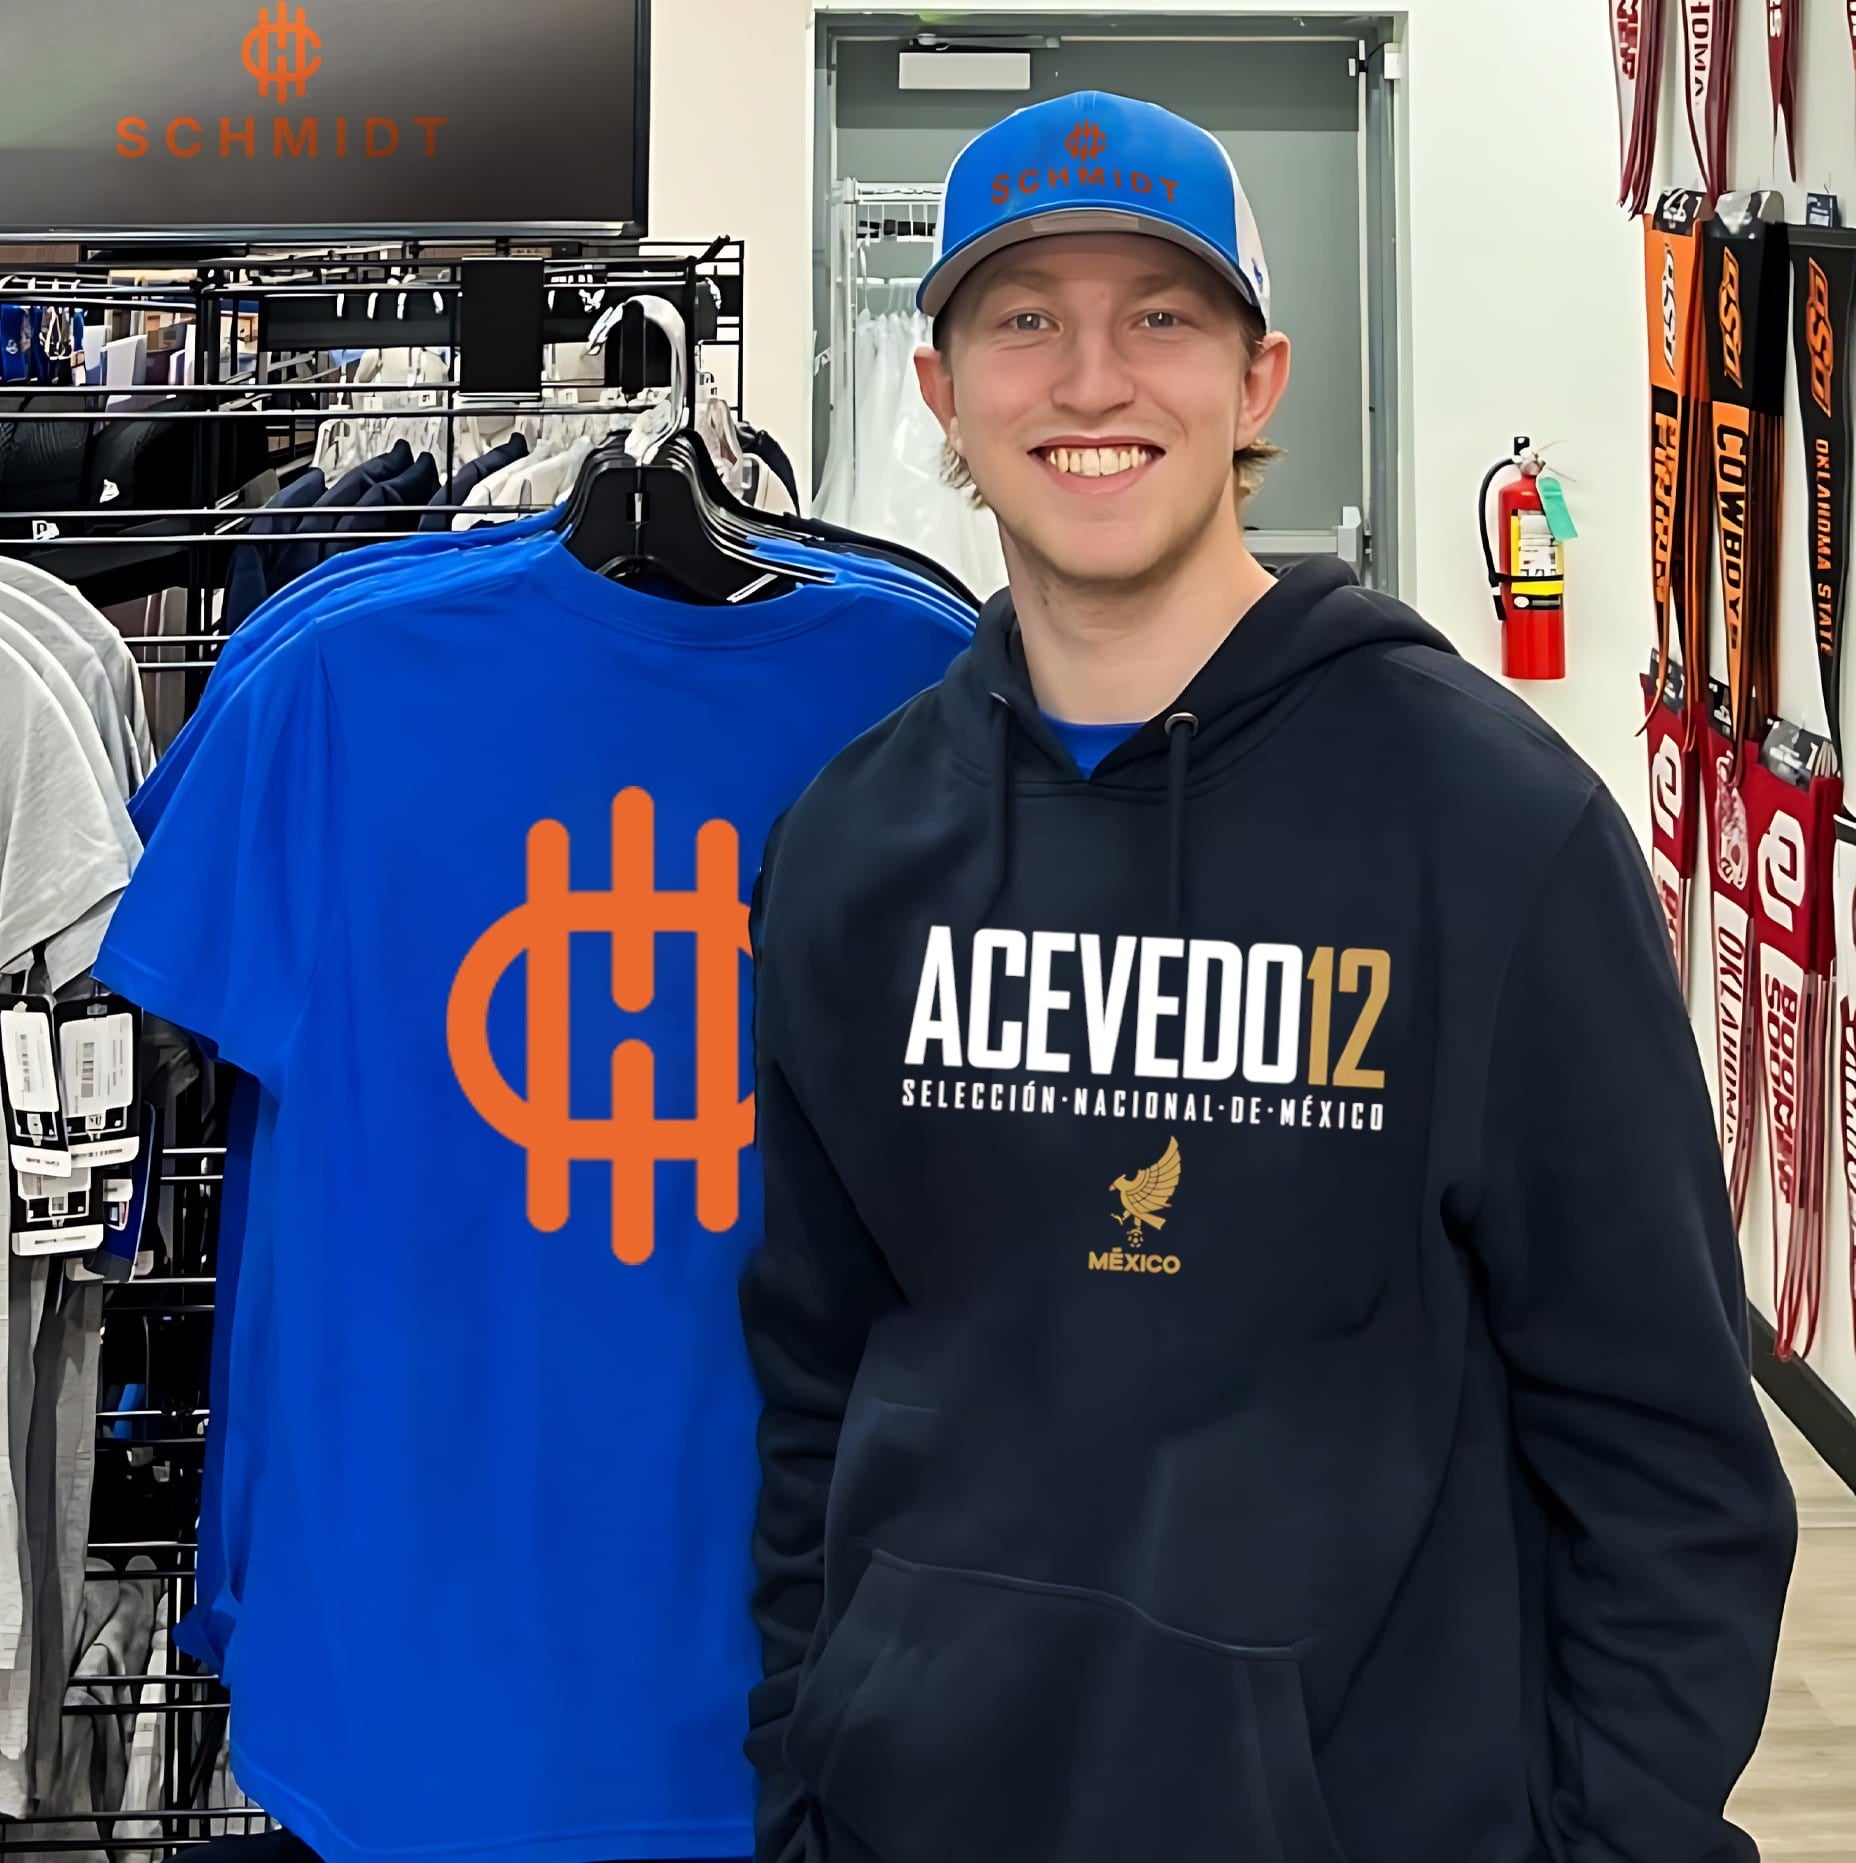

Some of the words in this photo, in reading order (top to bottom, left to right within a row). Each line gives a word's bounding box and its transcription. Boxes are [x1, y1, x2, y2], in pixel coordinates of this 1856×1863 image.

[116, 116, 447, 158] SCHMIDT
[992, 167, 1179, 204] SCHMIDT
[1815, 438, 1832, 570] OKLAHOMA
[1718, 926, 1744, 1144] OKLAHOMA
[1088, 1247, 1181, 1275] MÉXICO
